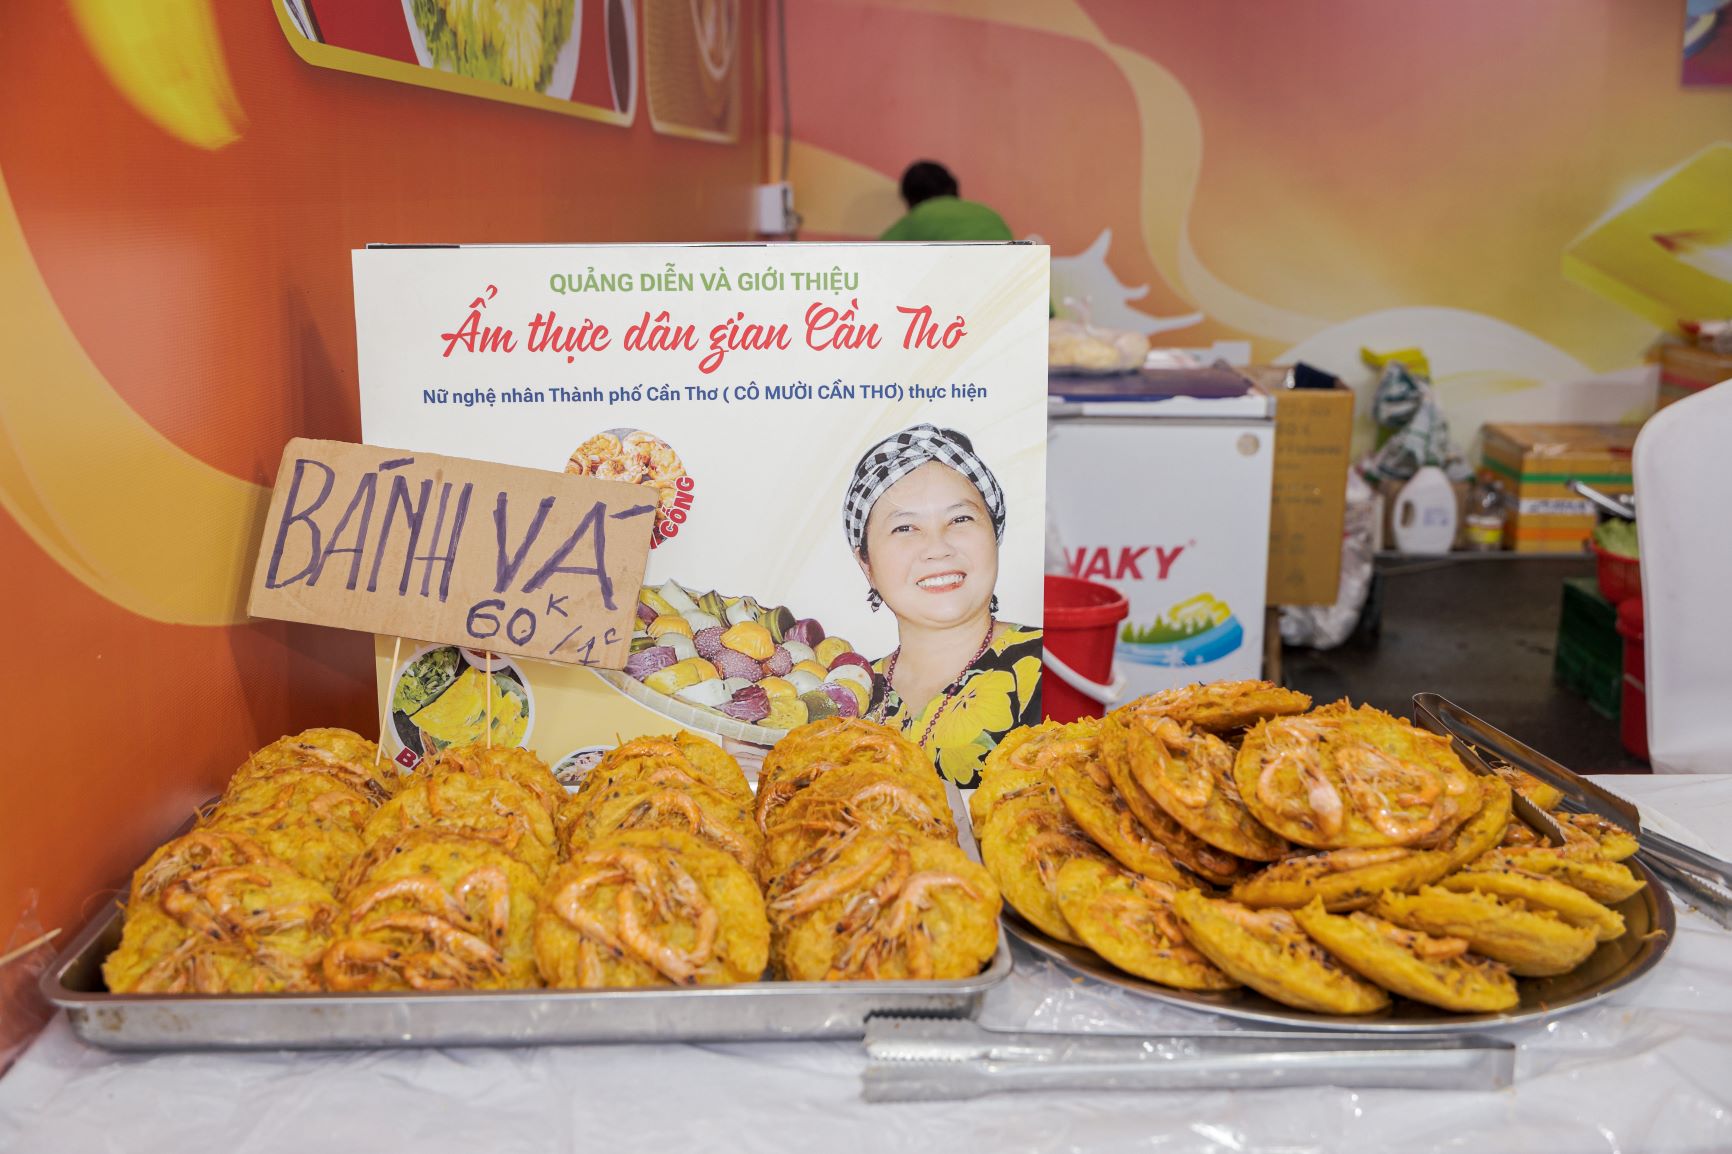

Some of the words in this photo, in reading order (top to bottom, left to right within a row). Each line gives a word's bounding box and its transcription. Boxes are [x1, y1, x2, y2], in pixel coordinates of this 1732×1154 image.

[549, 266, 634, 294] QUẢNG
[640, 262, 694, 291] DIỄN
[700, 266, 731, 291] VÀ
[738, 266, 785, 291] GIỚI
[790, 266, 859, 295] THIỆU
[441, 284, 518, 358] Ẩm
[527, 310, 612, 364] thực
[623, 310, 699, 352] dân
[698, 311, 792, 374] gian
[804, 297, 882, 352] Cần
[896, 304, 968, 350] Thơ
[423, 388, 448, 404] Nữ
[452, 389, 496, 407] nghệ
[501, 387, 545, 403] nhân
[548, 386, 604, 402] Thành
[609, 383, 643, 406] phố
[646, 383, 681, 402] Cần
[685, 386, 719, 401] Thơ
[734, 381, 760, 401] CÔ
[765, 380, 813, 401] MƯỜI
[817, 379, 855, 400] CẦN
[860, 383, 904, 403] THƠ)
[908, 384, 947, 404] thực
[951, 383, 988, 403] hiện
[265, 457, 474, 603] BÁNH
[492, 492, 657, 610] VÁ
[659, 475, 695, 538] CỐNG
